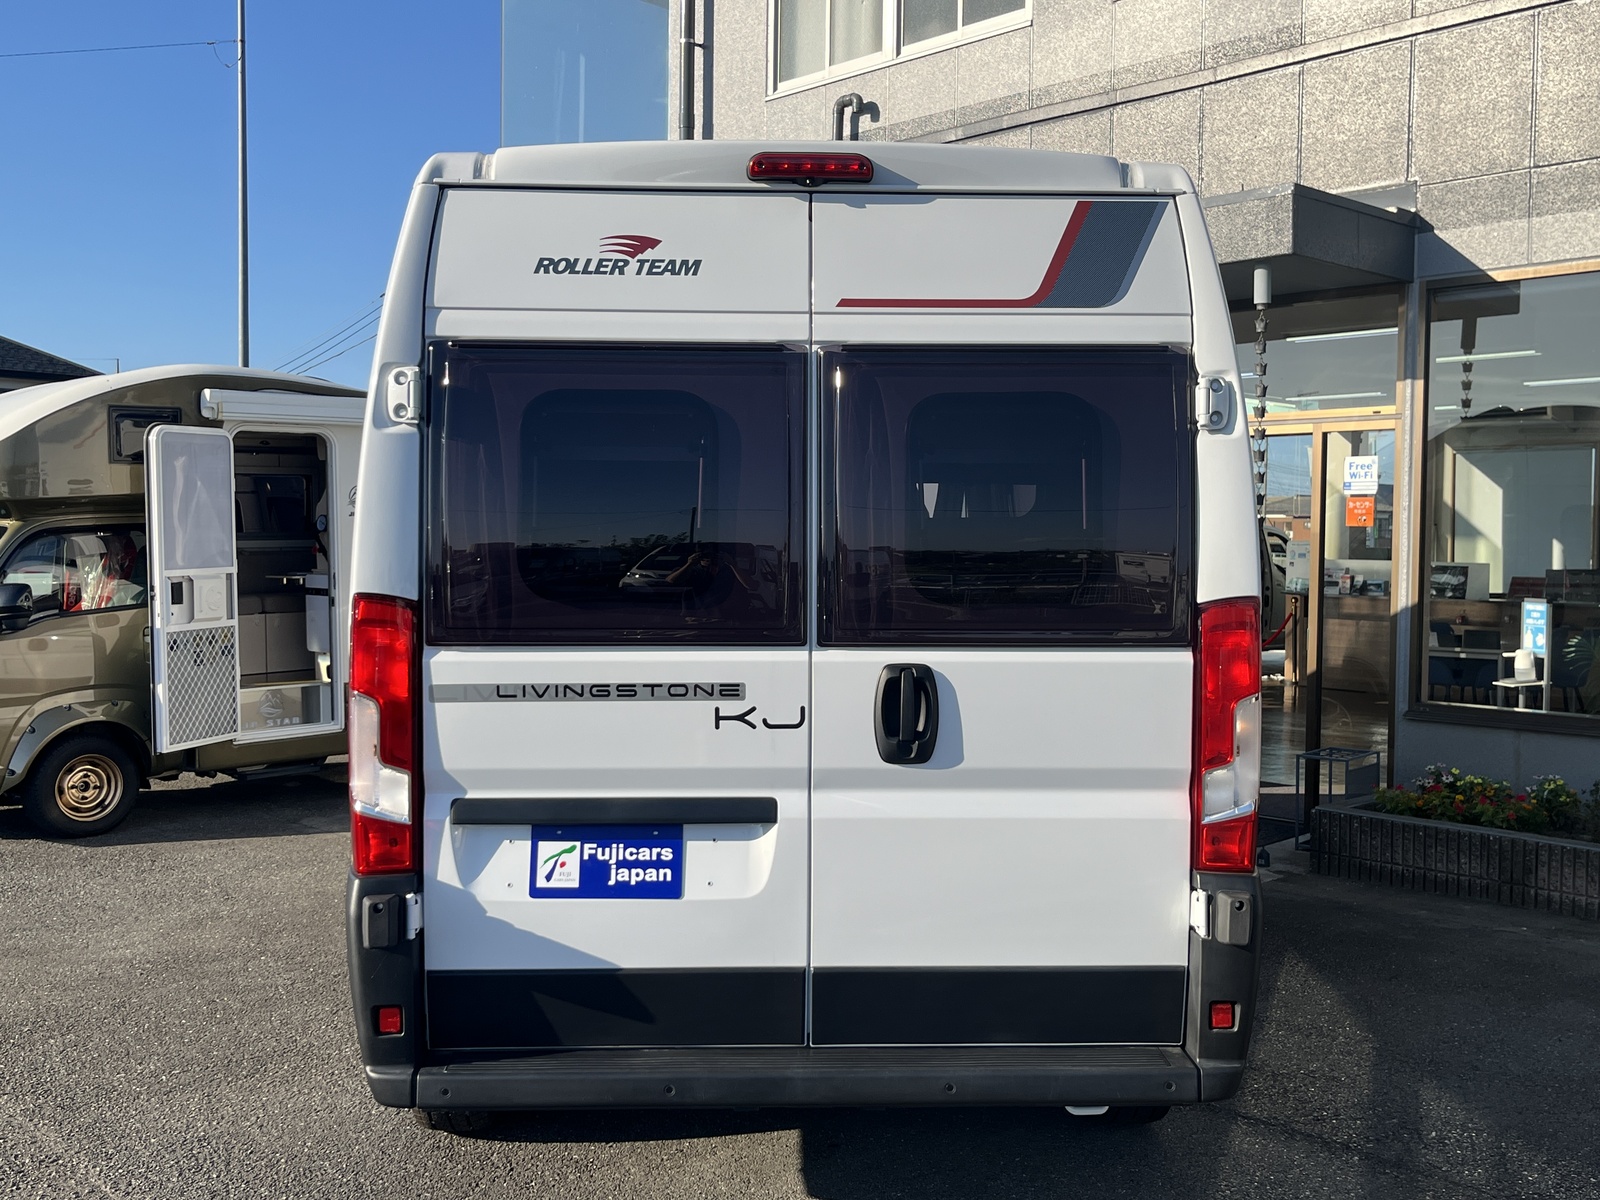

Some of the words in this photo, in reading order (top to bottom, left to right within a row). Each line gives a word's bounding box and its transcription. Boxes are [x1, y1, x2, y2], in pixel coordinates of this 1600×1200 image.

[533, 257, 630, 275] ROLLER
[634, 258, 703, 276] TEAM
[1349, 462, 1373, 470] Free
[1349, 471, 1373, 479] Wi-Fi
[496, 683, 741, 699] LIVINGSTONE
[714, 705, 806, 730] KJ
[583, 843, 673, 864] Fujicars
[608, 864, 672, 885] japan
